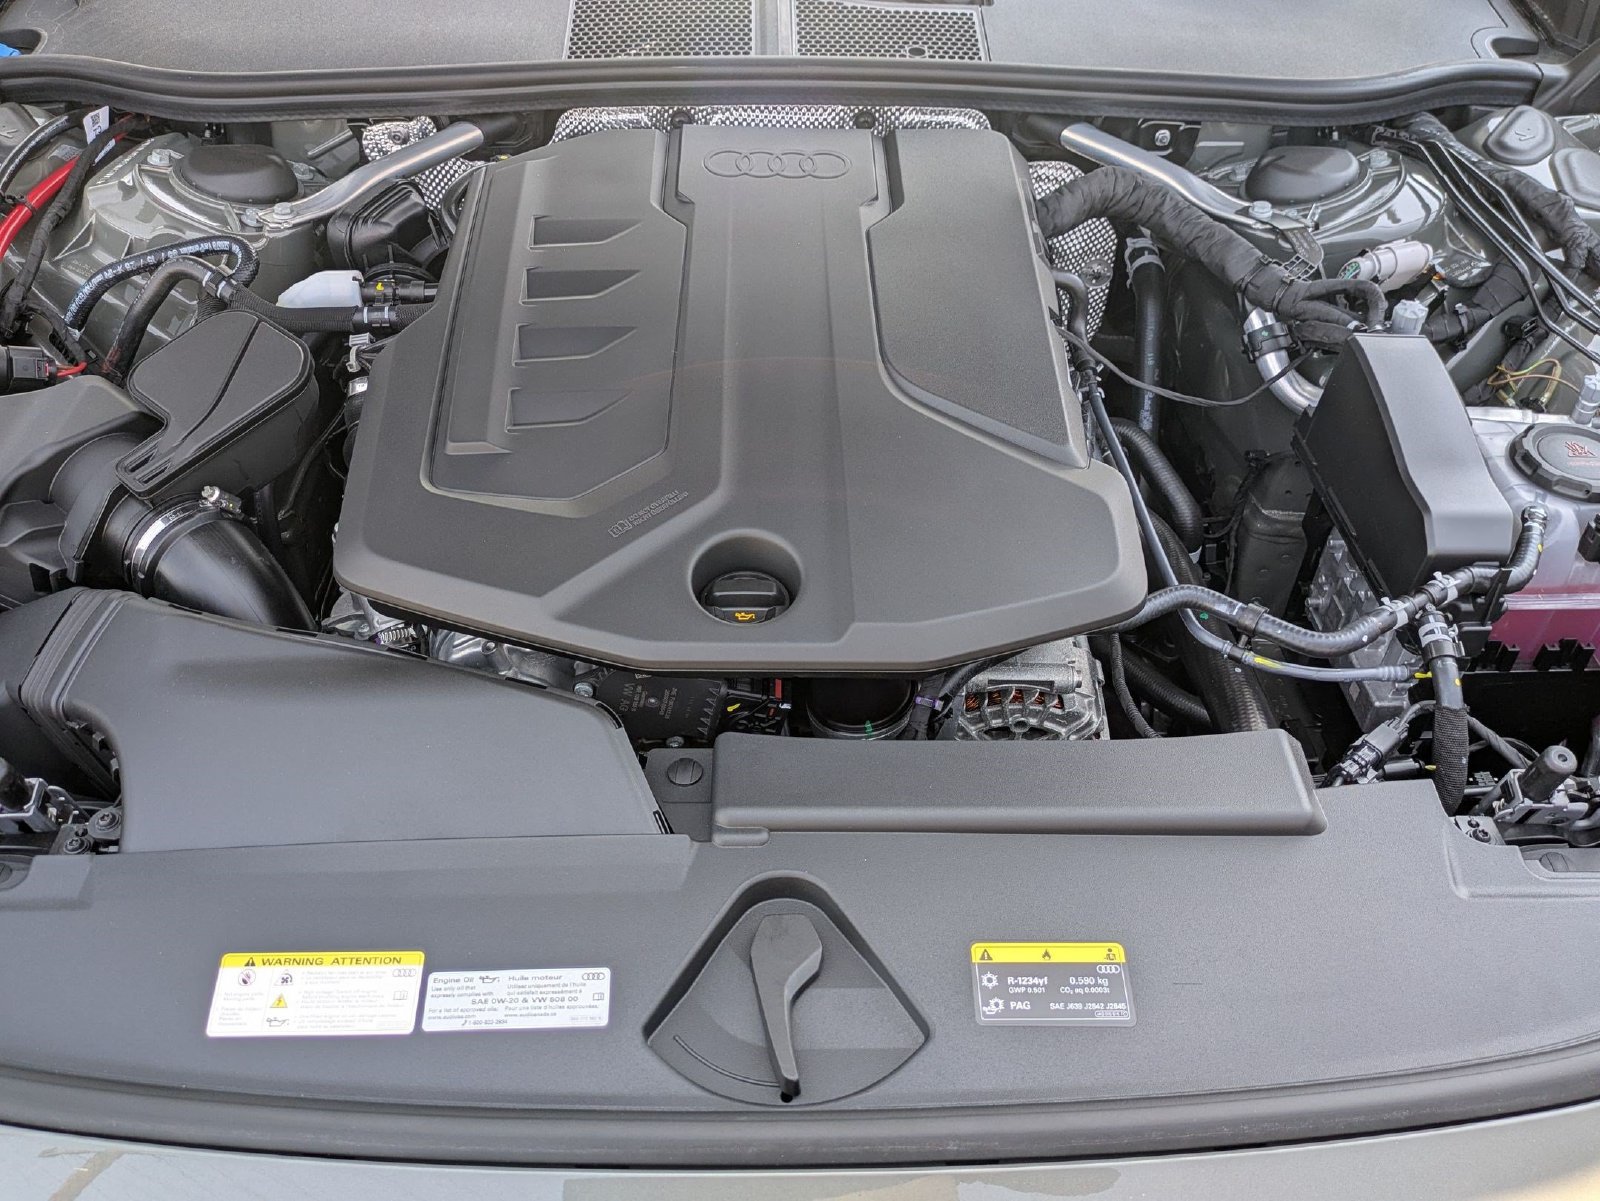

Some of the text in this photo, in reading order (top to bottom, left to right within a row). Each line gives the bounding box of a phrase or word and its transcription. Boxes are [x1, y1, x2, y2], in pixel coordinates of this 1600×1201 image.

[261, 956, 402, 966] WARNING ATTENTION
[1007, 976, 1109, 987] R-1234yf 0.590 kg
[1008, 986, 1026, 994] GWP
[1009, 1001, 1031, 1010] PAG
[1049, 1002, 1066, 1010] SAE
